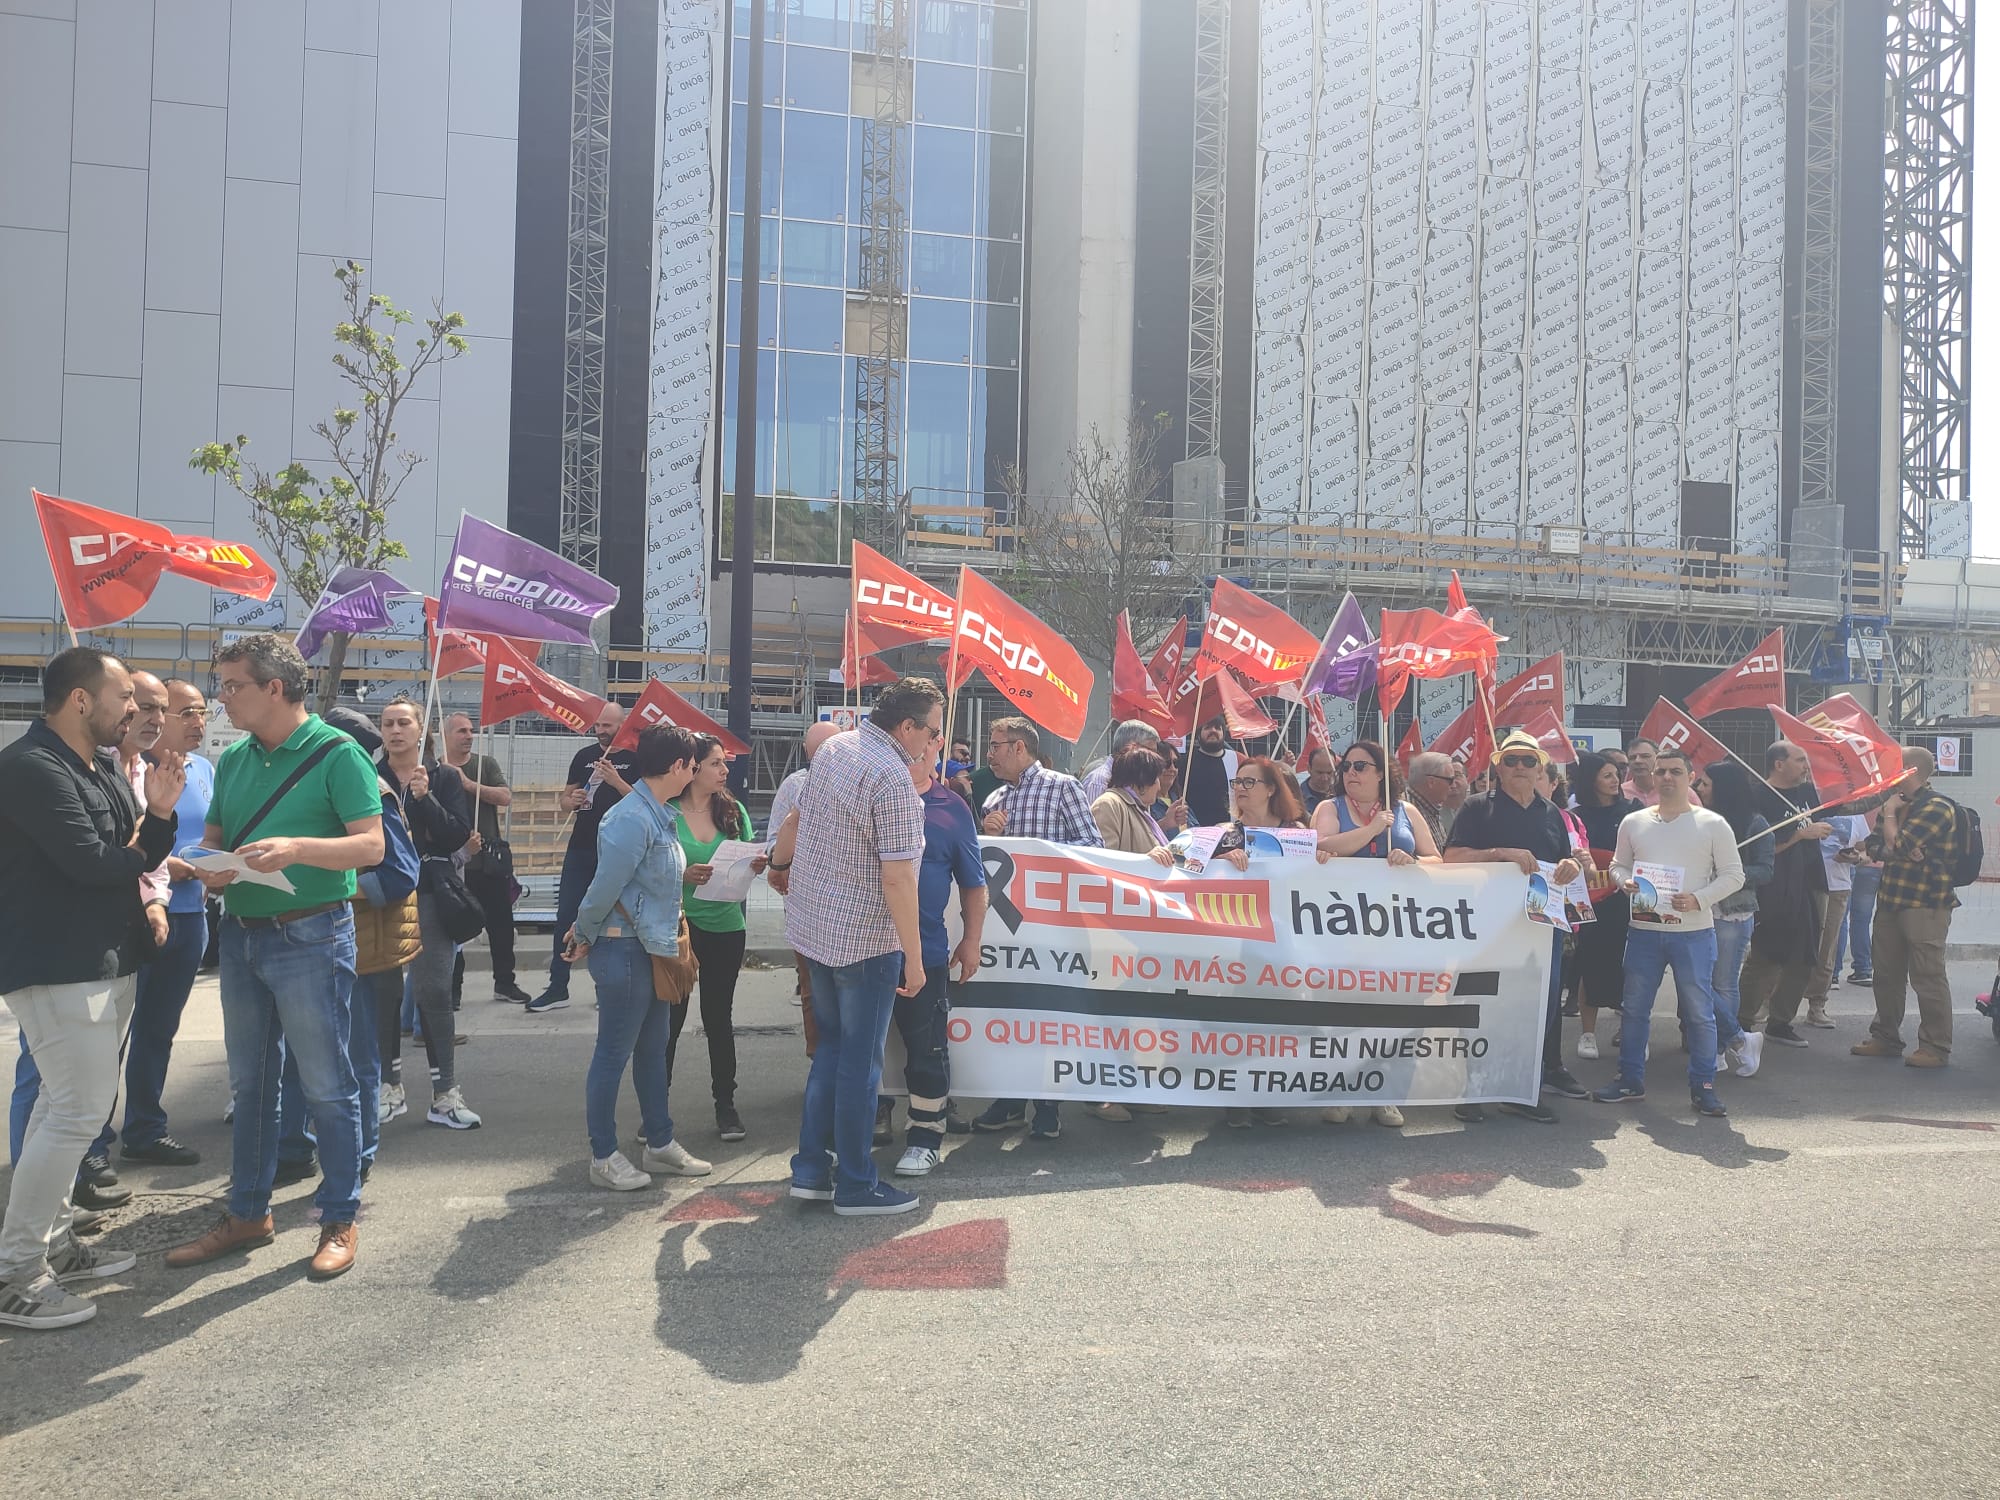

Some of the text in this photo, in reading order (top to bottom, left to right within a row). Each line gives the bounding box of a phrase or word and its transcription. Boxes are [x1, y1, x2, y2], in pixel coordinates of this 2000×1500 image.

[681, 28, 705, 44] BOND
[680, 75, 703, 90] BOND
[679, 121, 702, 136] BOND
[678, 167, 701, 183] BOND
[676, 233, 699, 249] BOND
[674, 280, 698, 295] BOND
[674, 326, 697, 342] BOND
[672, 372, 696, 388] BOND
[670, 455, 694, 470] BOND
[669, 501, 693, 517] BOND
[668, 548, 692, 564] BOND
[667, 594, 691, 610] BOND
[237, 608, 264, 625] BOND
[667, 630, 690, 646] BOND
[1290, 890, 1478, 941] hàbitat
[979, 944, 1453, 993] STA YA, NO MÁS ACCIDENTES
[947, 1018, 1489, 1059] O QUEREMOS MORIR EN NUESTRO
[1053, 1060, 1384, 1093] PUESTO DE TRABAJO
